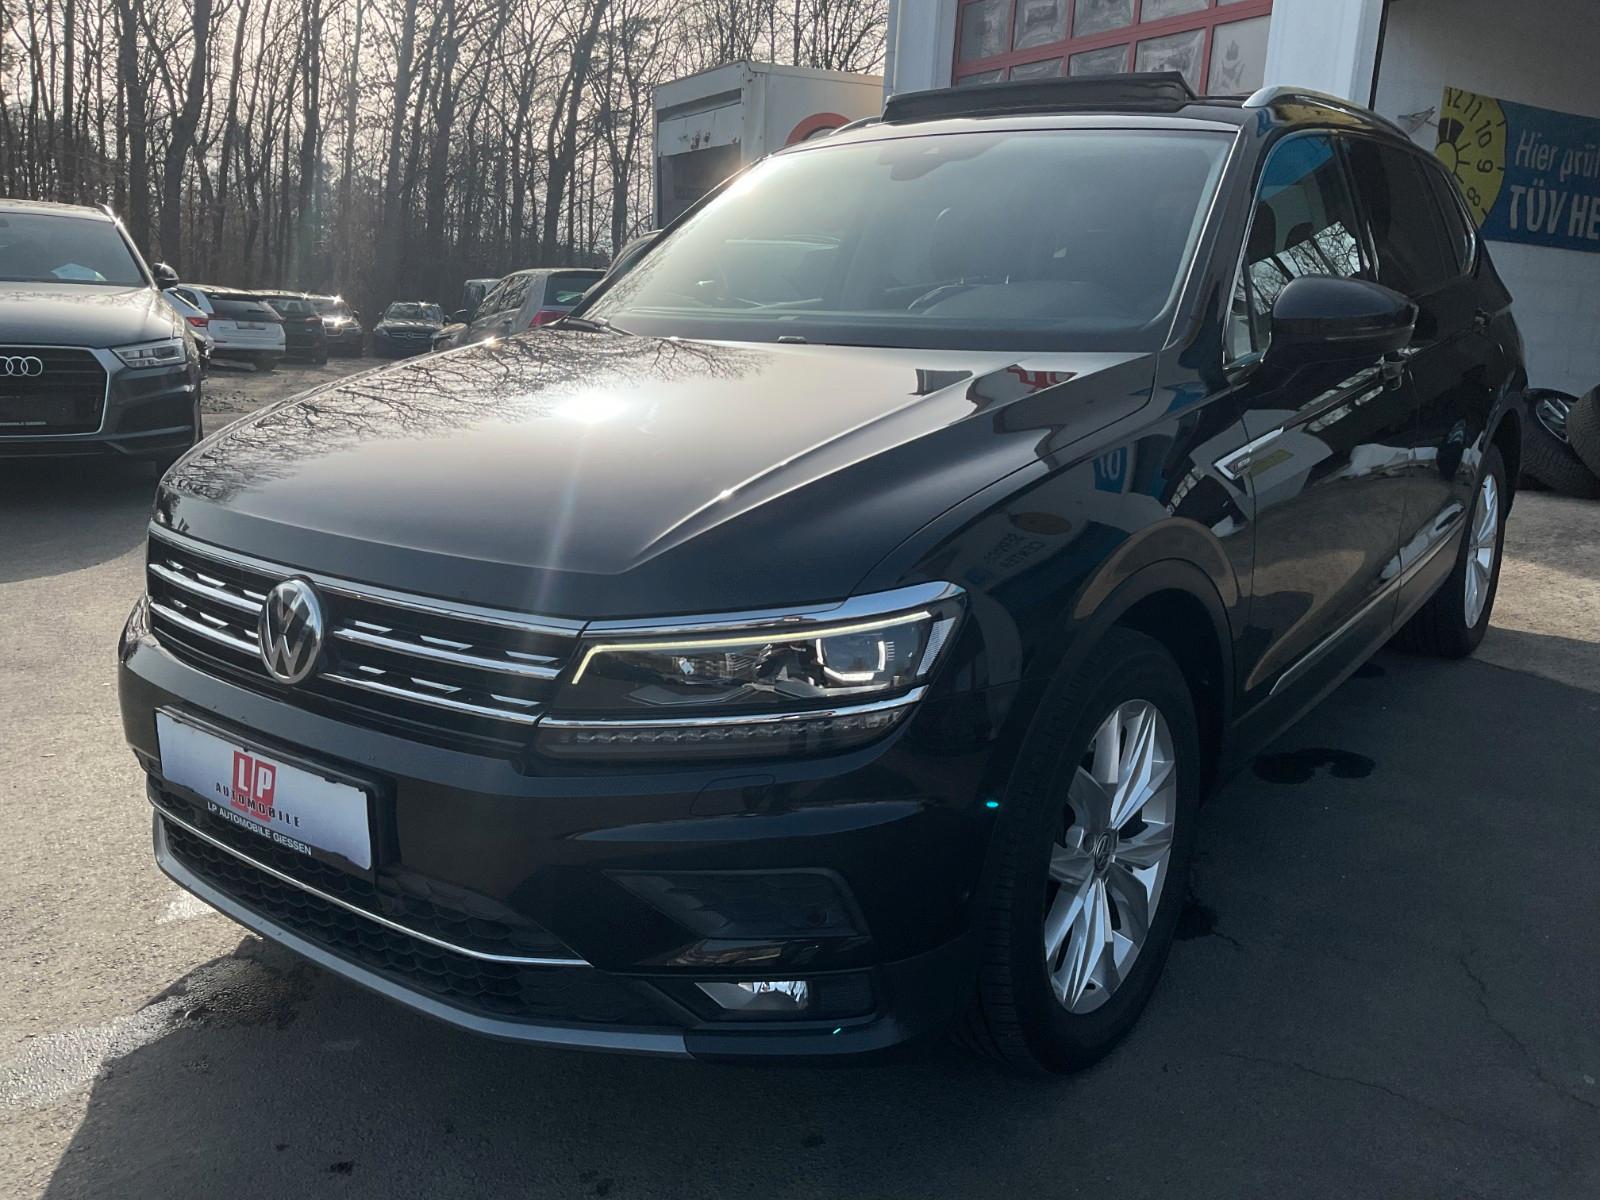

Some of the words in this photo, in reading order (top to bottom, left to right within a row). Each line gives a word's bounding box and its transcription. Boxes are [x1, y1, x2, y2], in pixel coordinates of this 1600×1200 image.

[1447, 87, 1463, 109] 12
[1463, 94, 1482, 122] 11
[1475, 119, 1492, 148] 10
[1515, 129, 1559, 171] Hier
[1477, 159, 1494, 173] 9
[1466, 187, 1480, 206] 8
[1510, 178, 1568, 234] TÜV
[1568, 193, 1600, 240] HE
[237, 757, 273, 798] LP
[215, 782, 300, 827] AUTOMOBILE
[207, 801, 217, 812] LP
[219, 807, 271, 838] AUTOMOBILE
[272, 832, 312, 856] GIESSEN
